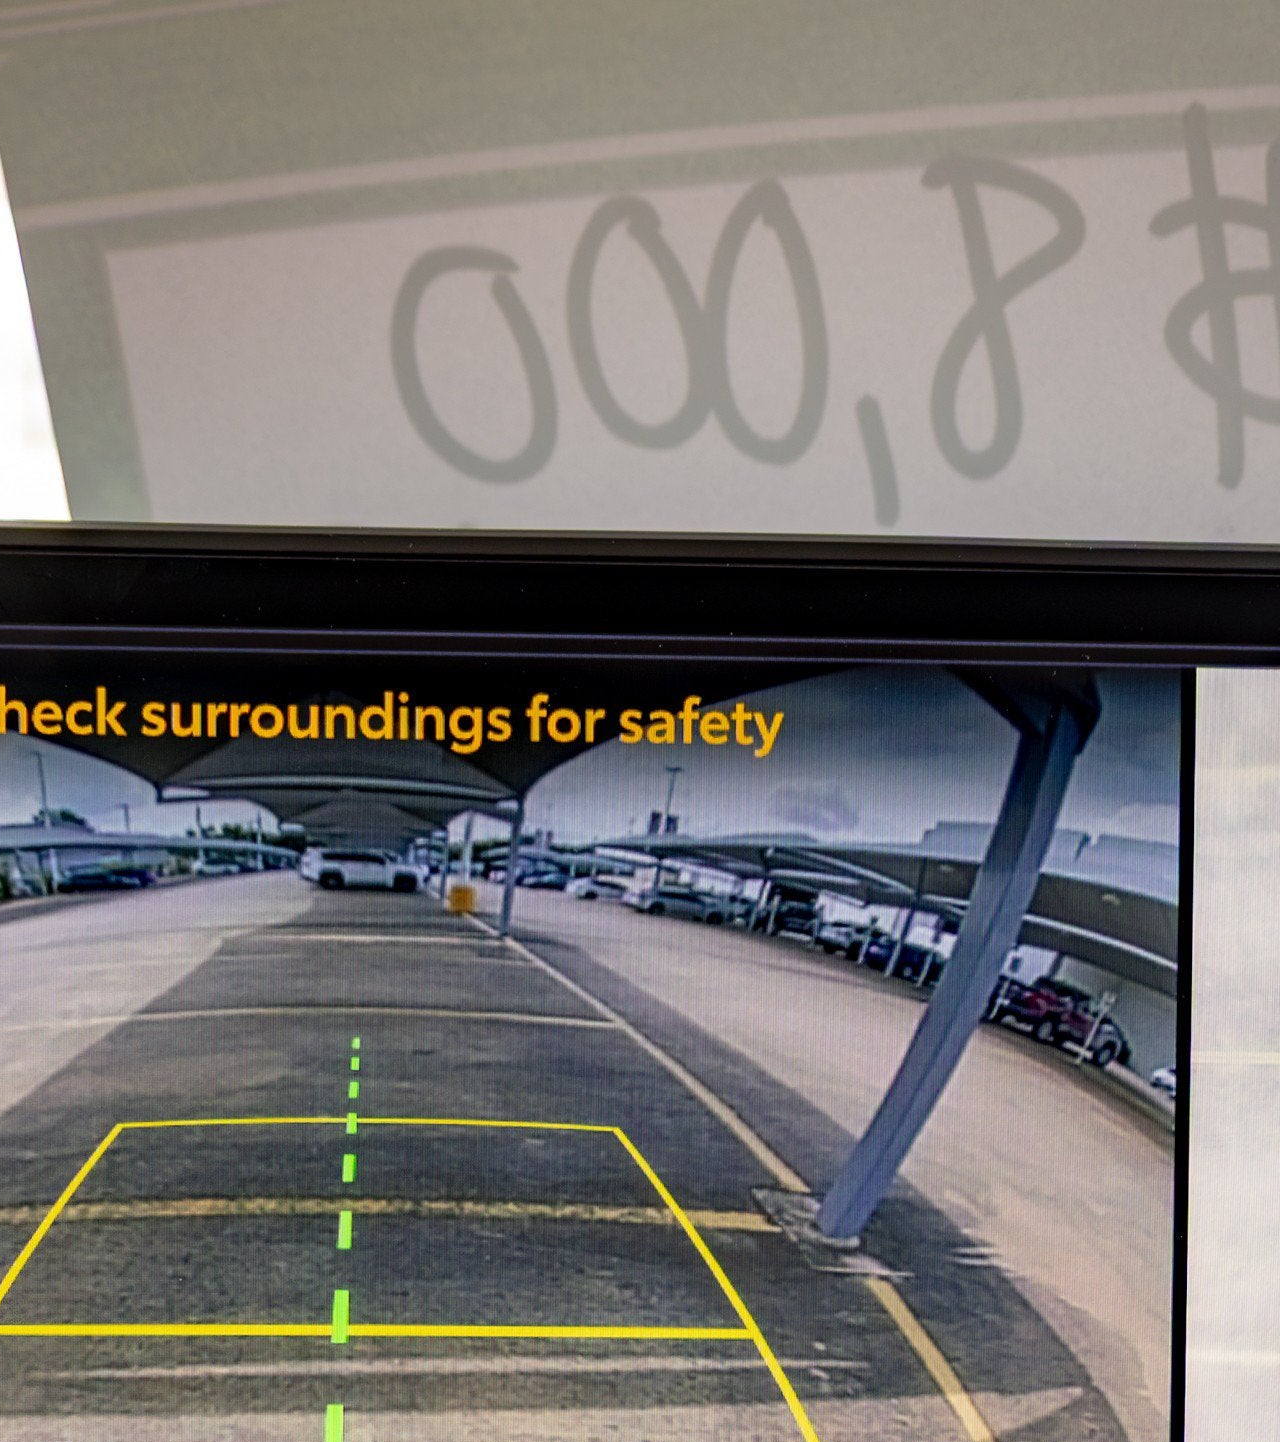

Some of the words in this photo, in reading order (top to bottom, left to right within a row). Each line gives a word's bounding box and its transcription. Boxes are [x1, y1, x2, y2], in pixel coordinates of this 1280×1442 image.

[141, 691, 512, 754] surroundings
[525, 693, 606, 742] for
[620, 695, 784, 757] safety
